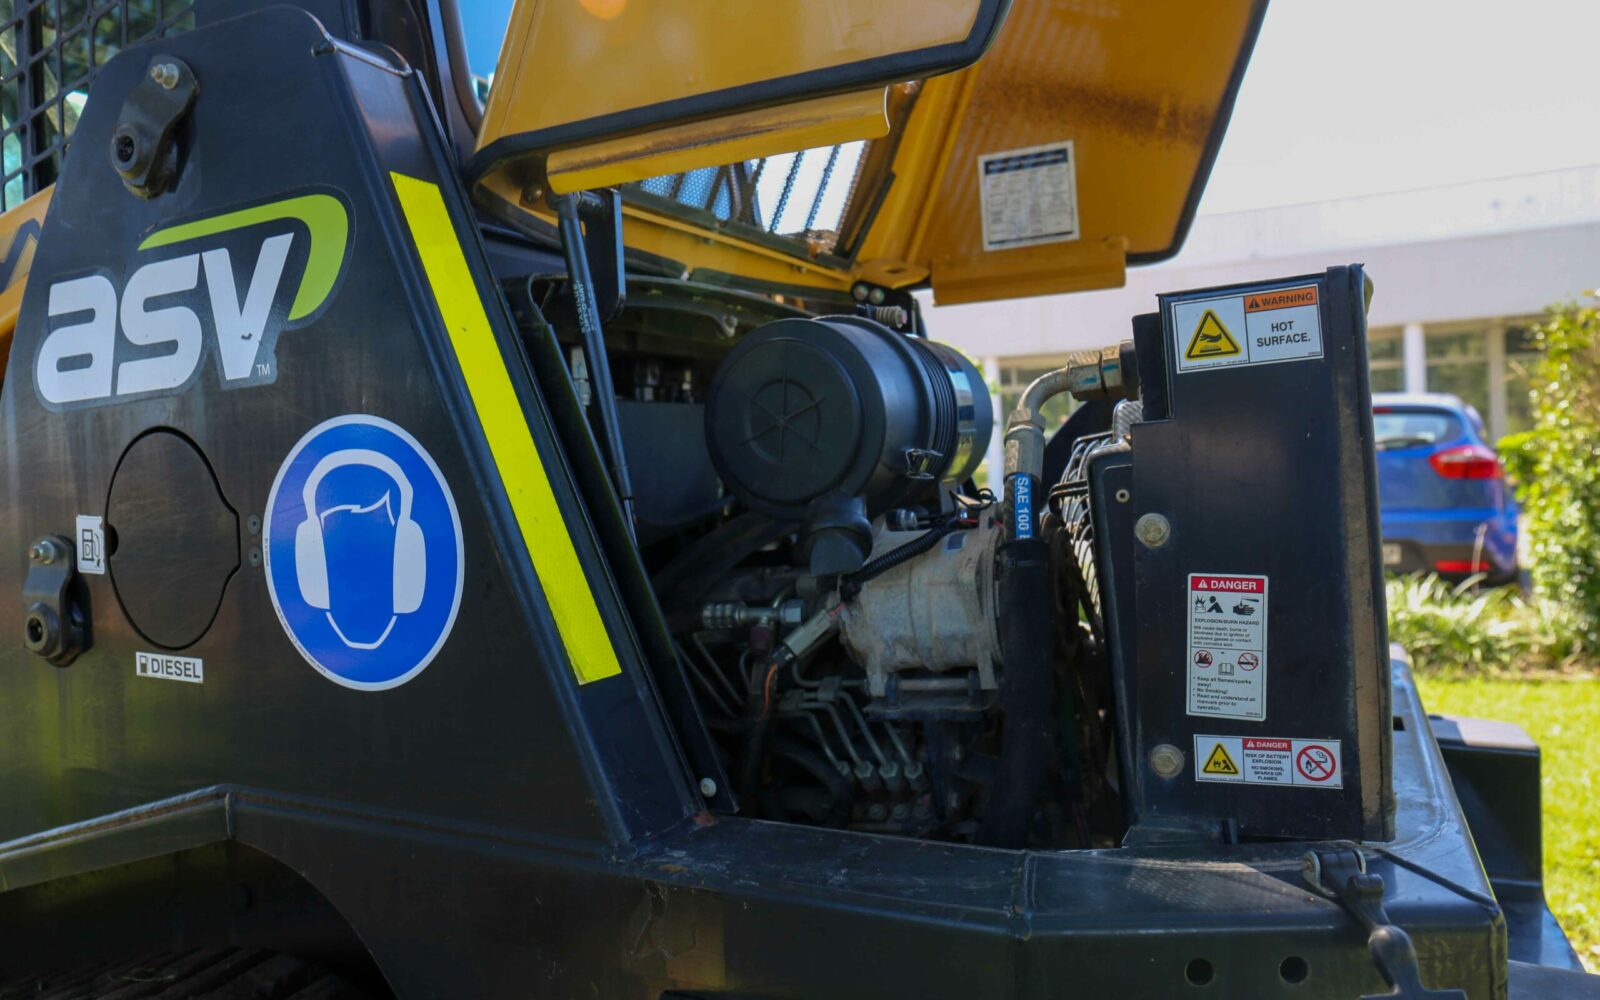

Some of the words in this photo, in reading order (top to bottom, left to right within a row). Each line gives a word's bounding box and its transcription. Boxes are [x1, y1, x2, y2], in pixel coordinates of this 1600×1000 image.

[1262, 292, 1313, 306] WARNING
[1272, 320, 1294, 332] HOT
[1256, 332, 1311, 348] SURFACE.
[1018, 477, 1029, 504] SAE
[1018, 507, 1030, 531] 100
[1210, 580, 1256, 590] DANGER
[151, 658, 201, 679] DIESEL
